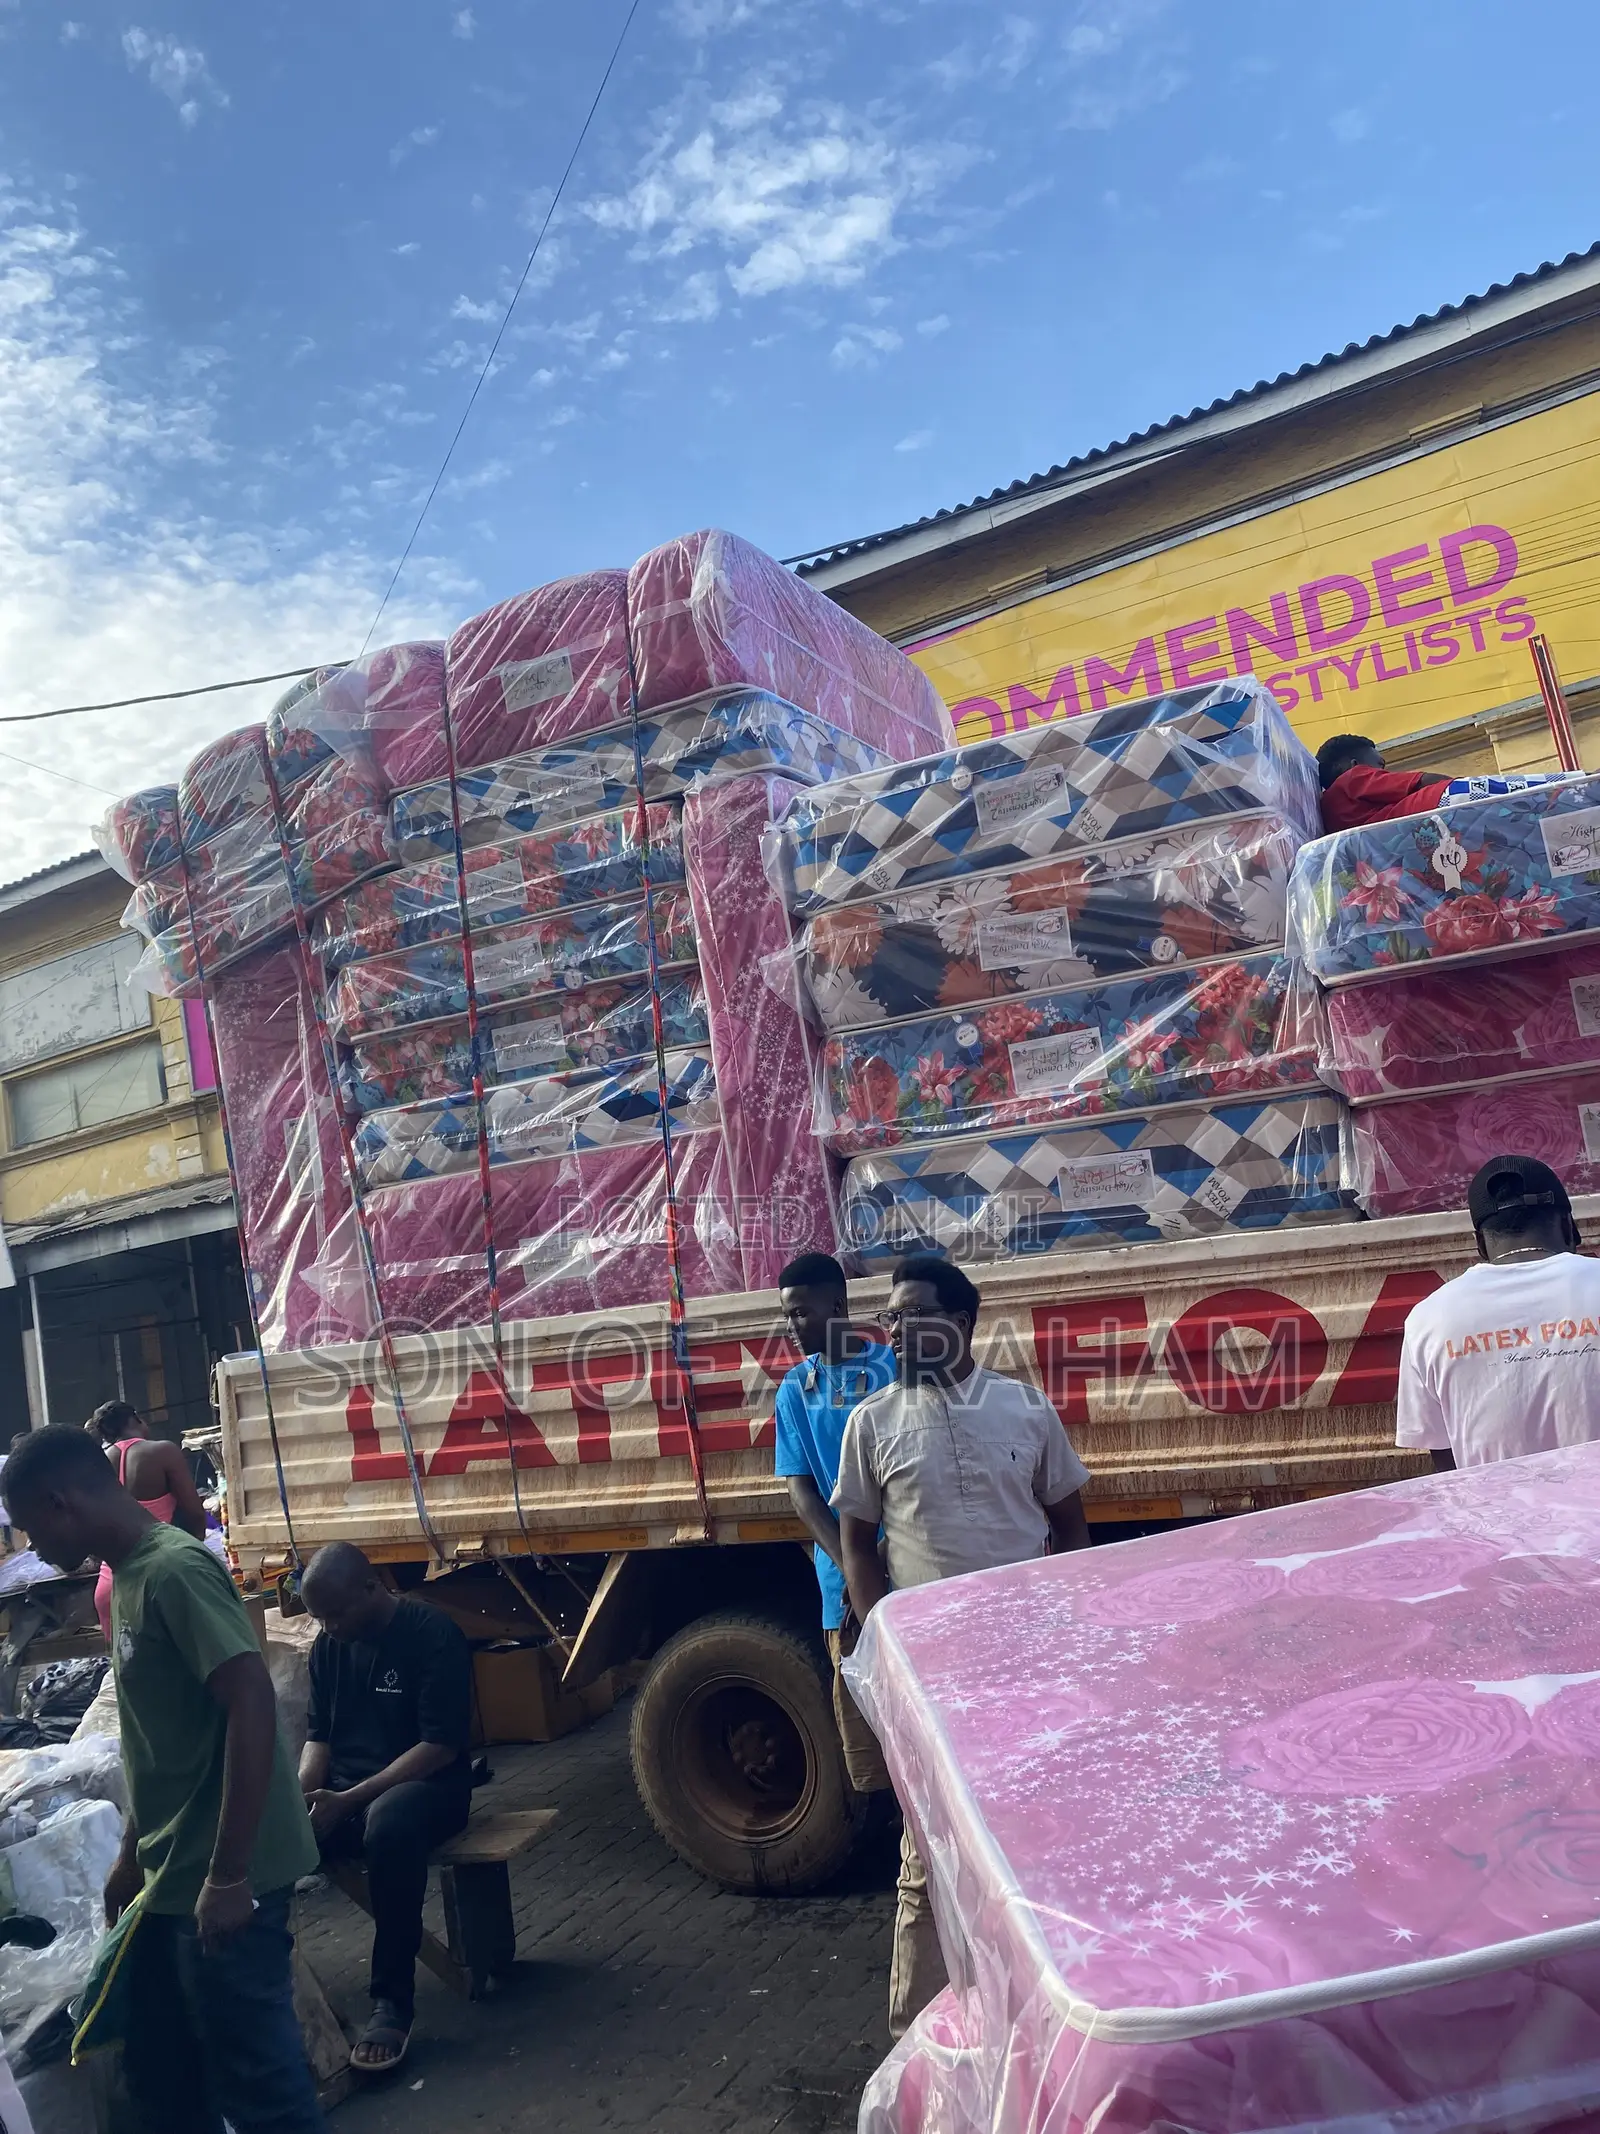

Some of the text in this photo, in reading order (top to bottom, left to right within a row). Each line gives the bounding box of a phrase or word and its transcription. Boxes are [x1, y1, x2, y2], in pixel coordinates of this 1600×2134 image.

[1205, 1190, 1230, 1219] LATEX
[1208, 1177, 1231, 1203] FOAM
[1031, 1270, 1446, 1425] FOA
[1446, 1316, 1600, 1360] LATEX FOA
[1504, 1352, 1532, 1364] Your
[1535, 1347, 1579, 1360] Partner
